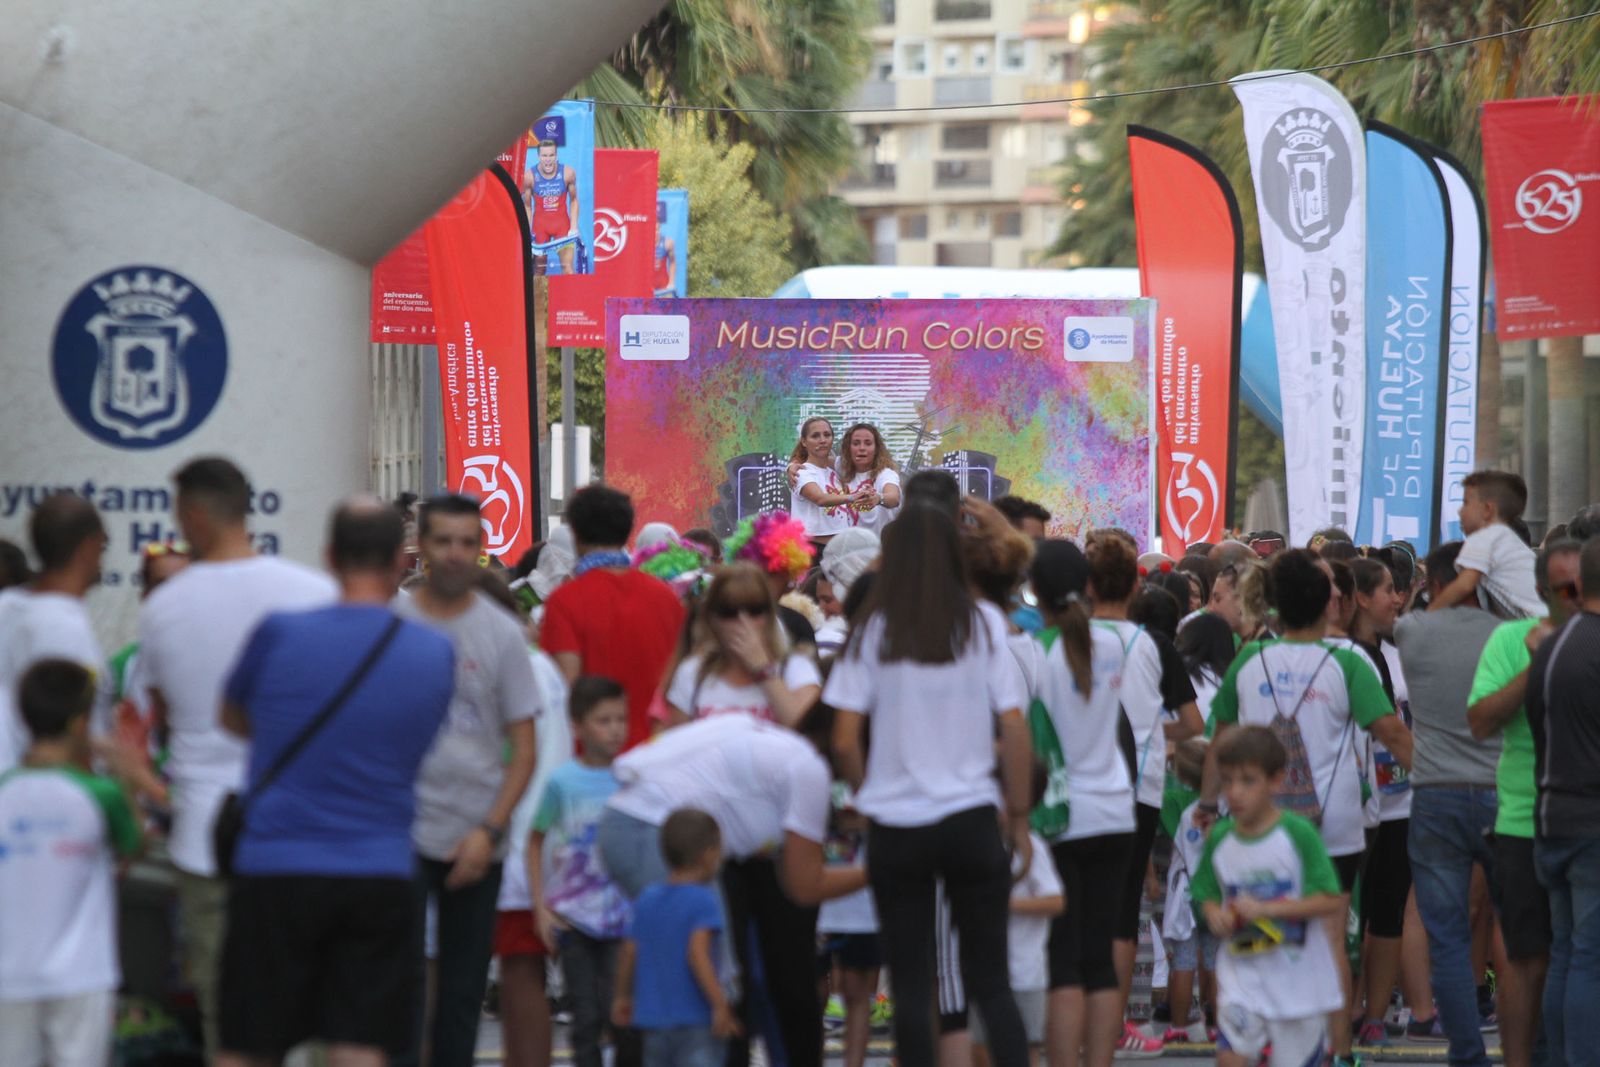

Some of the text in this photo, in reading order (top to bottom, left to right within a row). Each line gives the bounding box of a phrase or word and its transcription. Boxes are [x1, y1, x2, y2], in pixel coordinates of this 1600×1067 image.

[642, 330, 684, 338] DIPUTACIÓN
[716, 320, 1045, 350] MusicRun Colors
